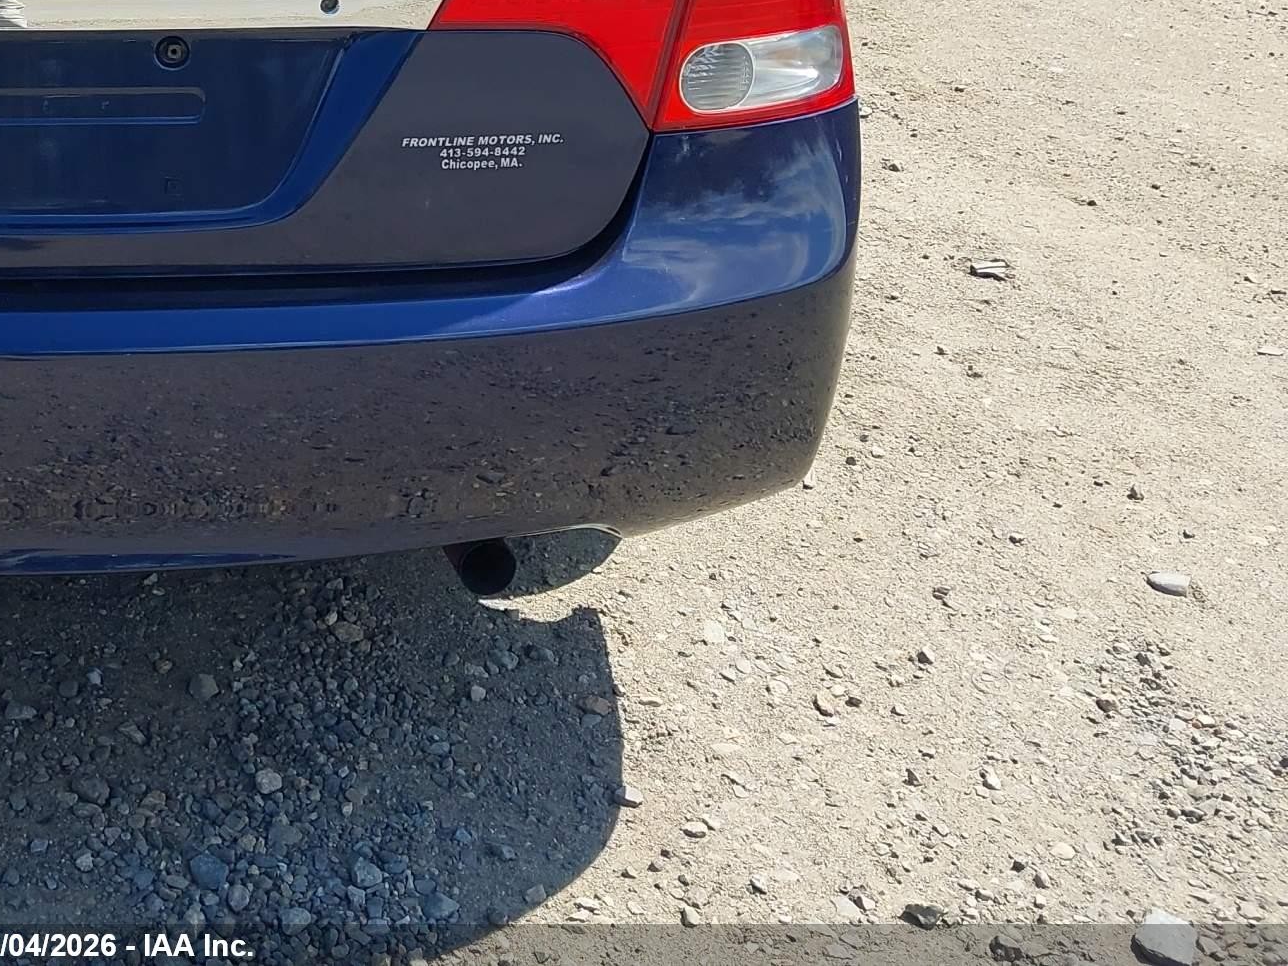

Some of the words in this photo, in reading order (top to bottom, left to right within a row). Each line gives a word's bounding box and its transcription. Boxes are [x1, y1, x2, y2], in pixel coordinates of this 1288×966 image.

[402, 137, 474, 147] FRONTLINE
[478, 135, 536, 146] MOTORS,
[538, 134, 564, 144] INC.
[439, 147, 526, 158] 413-594-8442
[441, 159, 498, 170] Chicopee,
[500, 158, 523, 168] MA.
